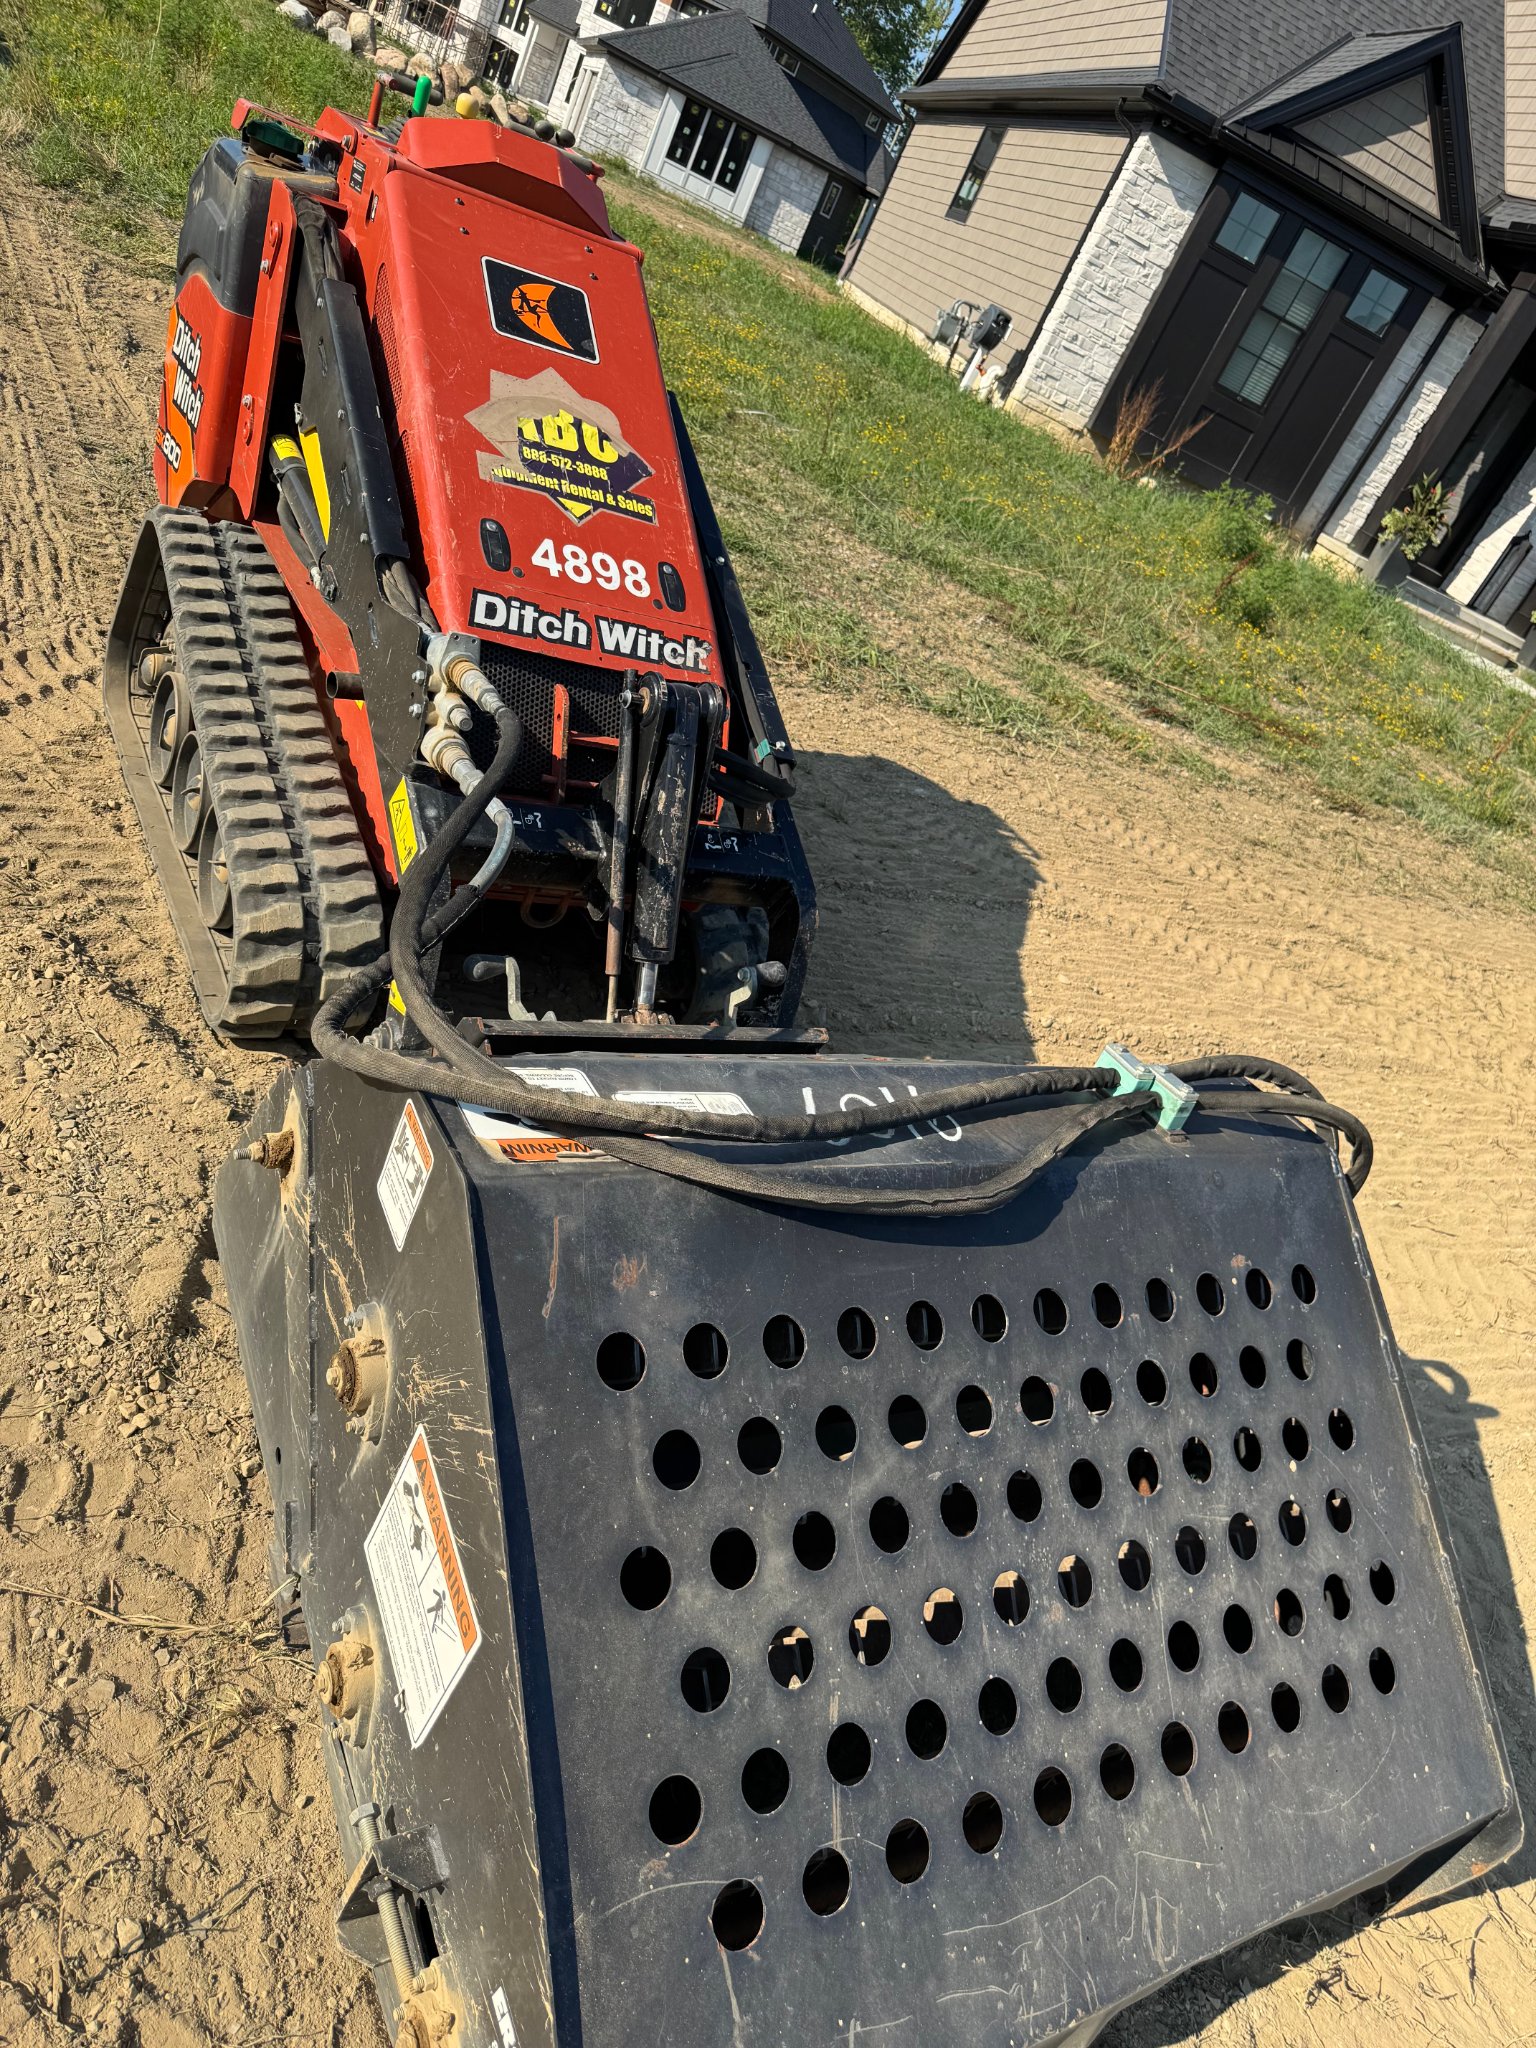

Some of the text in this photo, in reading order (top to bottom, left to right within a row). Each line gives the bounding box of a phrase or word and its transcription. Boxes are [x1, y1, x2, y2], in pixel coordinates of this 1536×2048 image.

[173, 318, 201, 377] Ditch
[173, 366, 202, 429] Witch
[606, 493, 616, 506] &
[617, 494, 653, 517] Sales
[531, 538, 651, 598] 4898
[473, 592, 708, 671] Ditch Witch
[424, 1480, 471, 1640] WARNING
